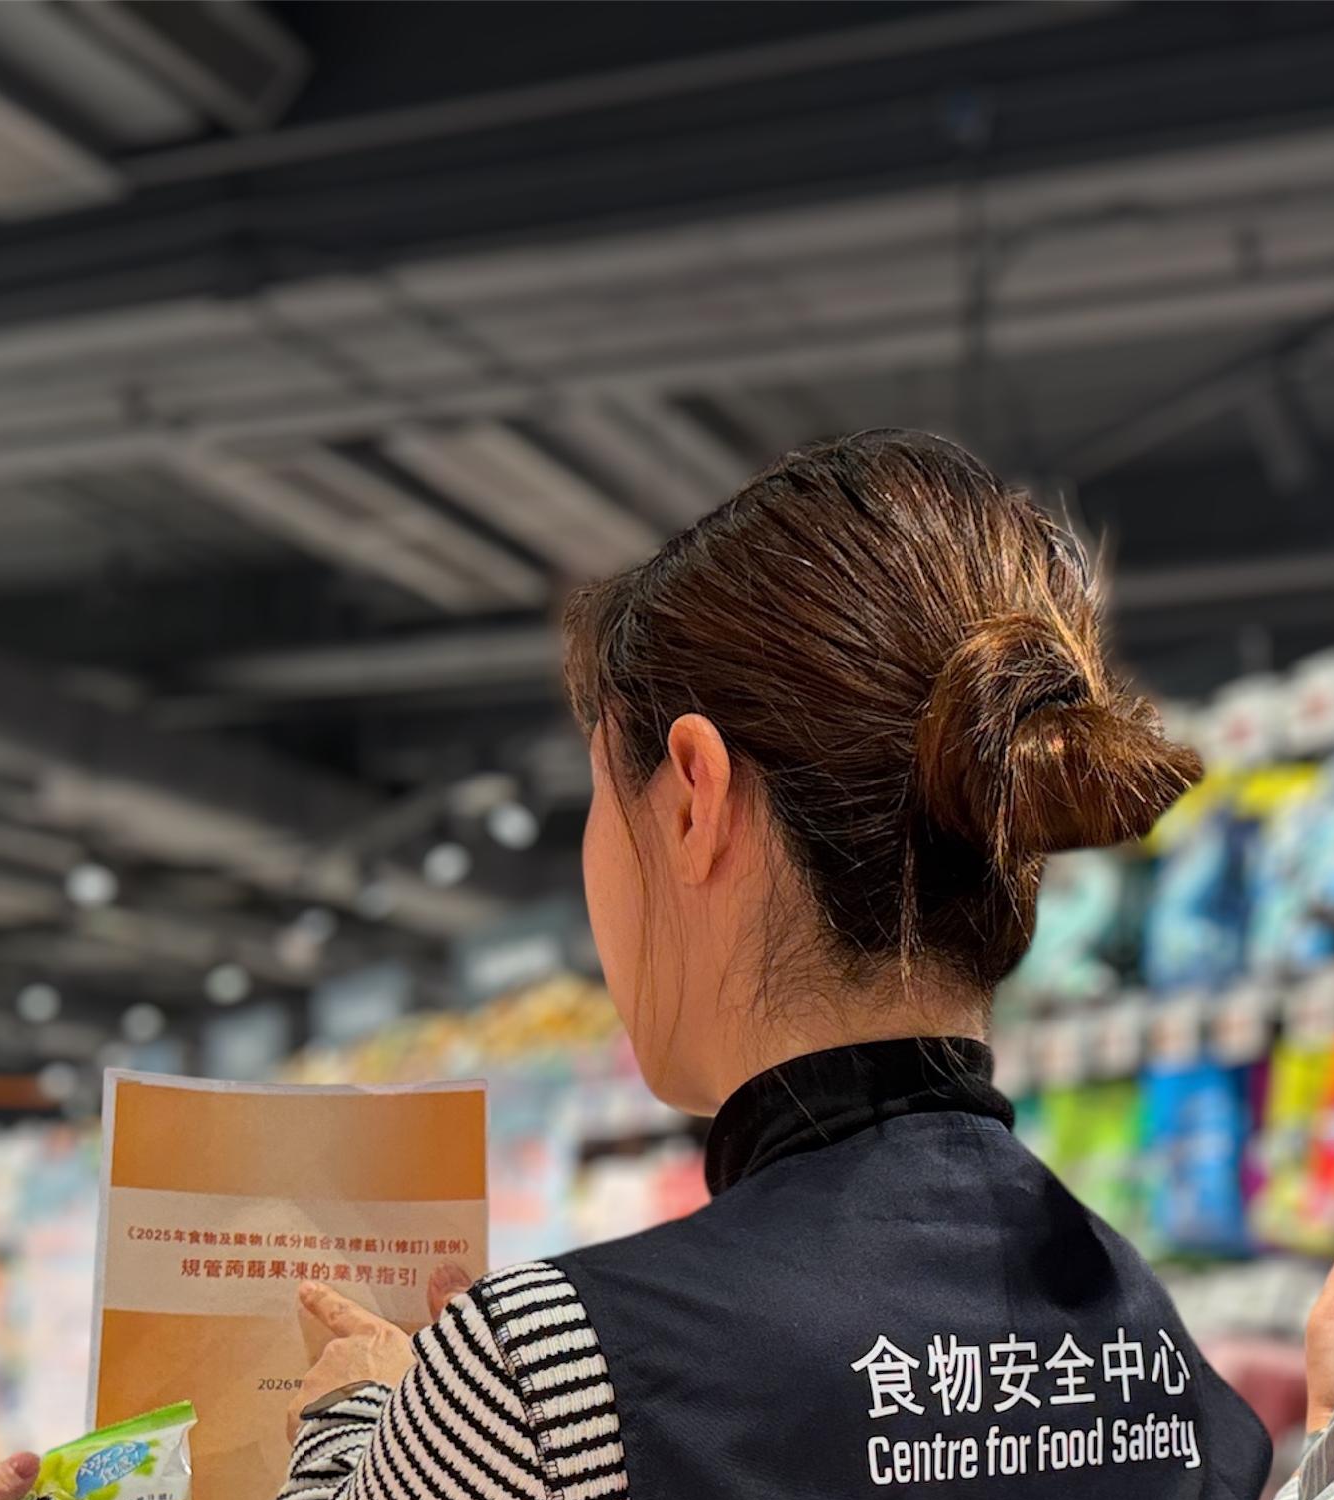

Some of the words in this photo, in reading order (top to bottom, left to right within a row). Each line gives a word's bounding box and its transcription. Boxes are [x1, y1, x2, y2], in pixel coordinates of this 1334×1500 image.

[850, 1326, 1192, 1420] 食物安全中心
[867, 1430, 979, 1486] Centre
[985, 1425, 1032, 1477] for
[1037, 1416, 1104, 1472] Food
[1111, 1412, 1202, 1470] Safety
